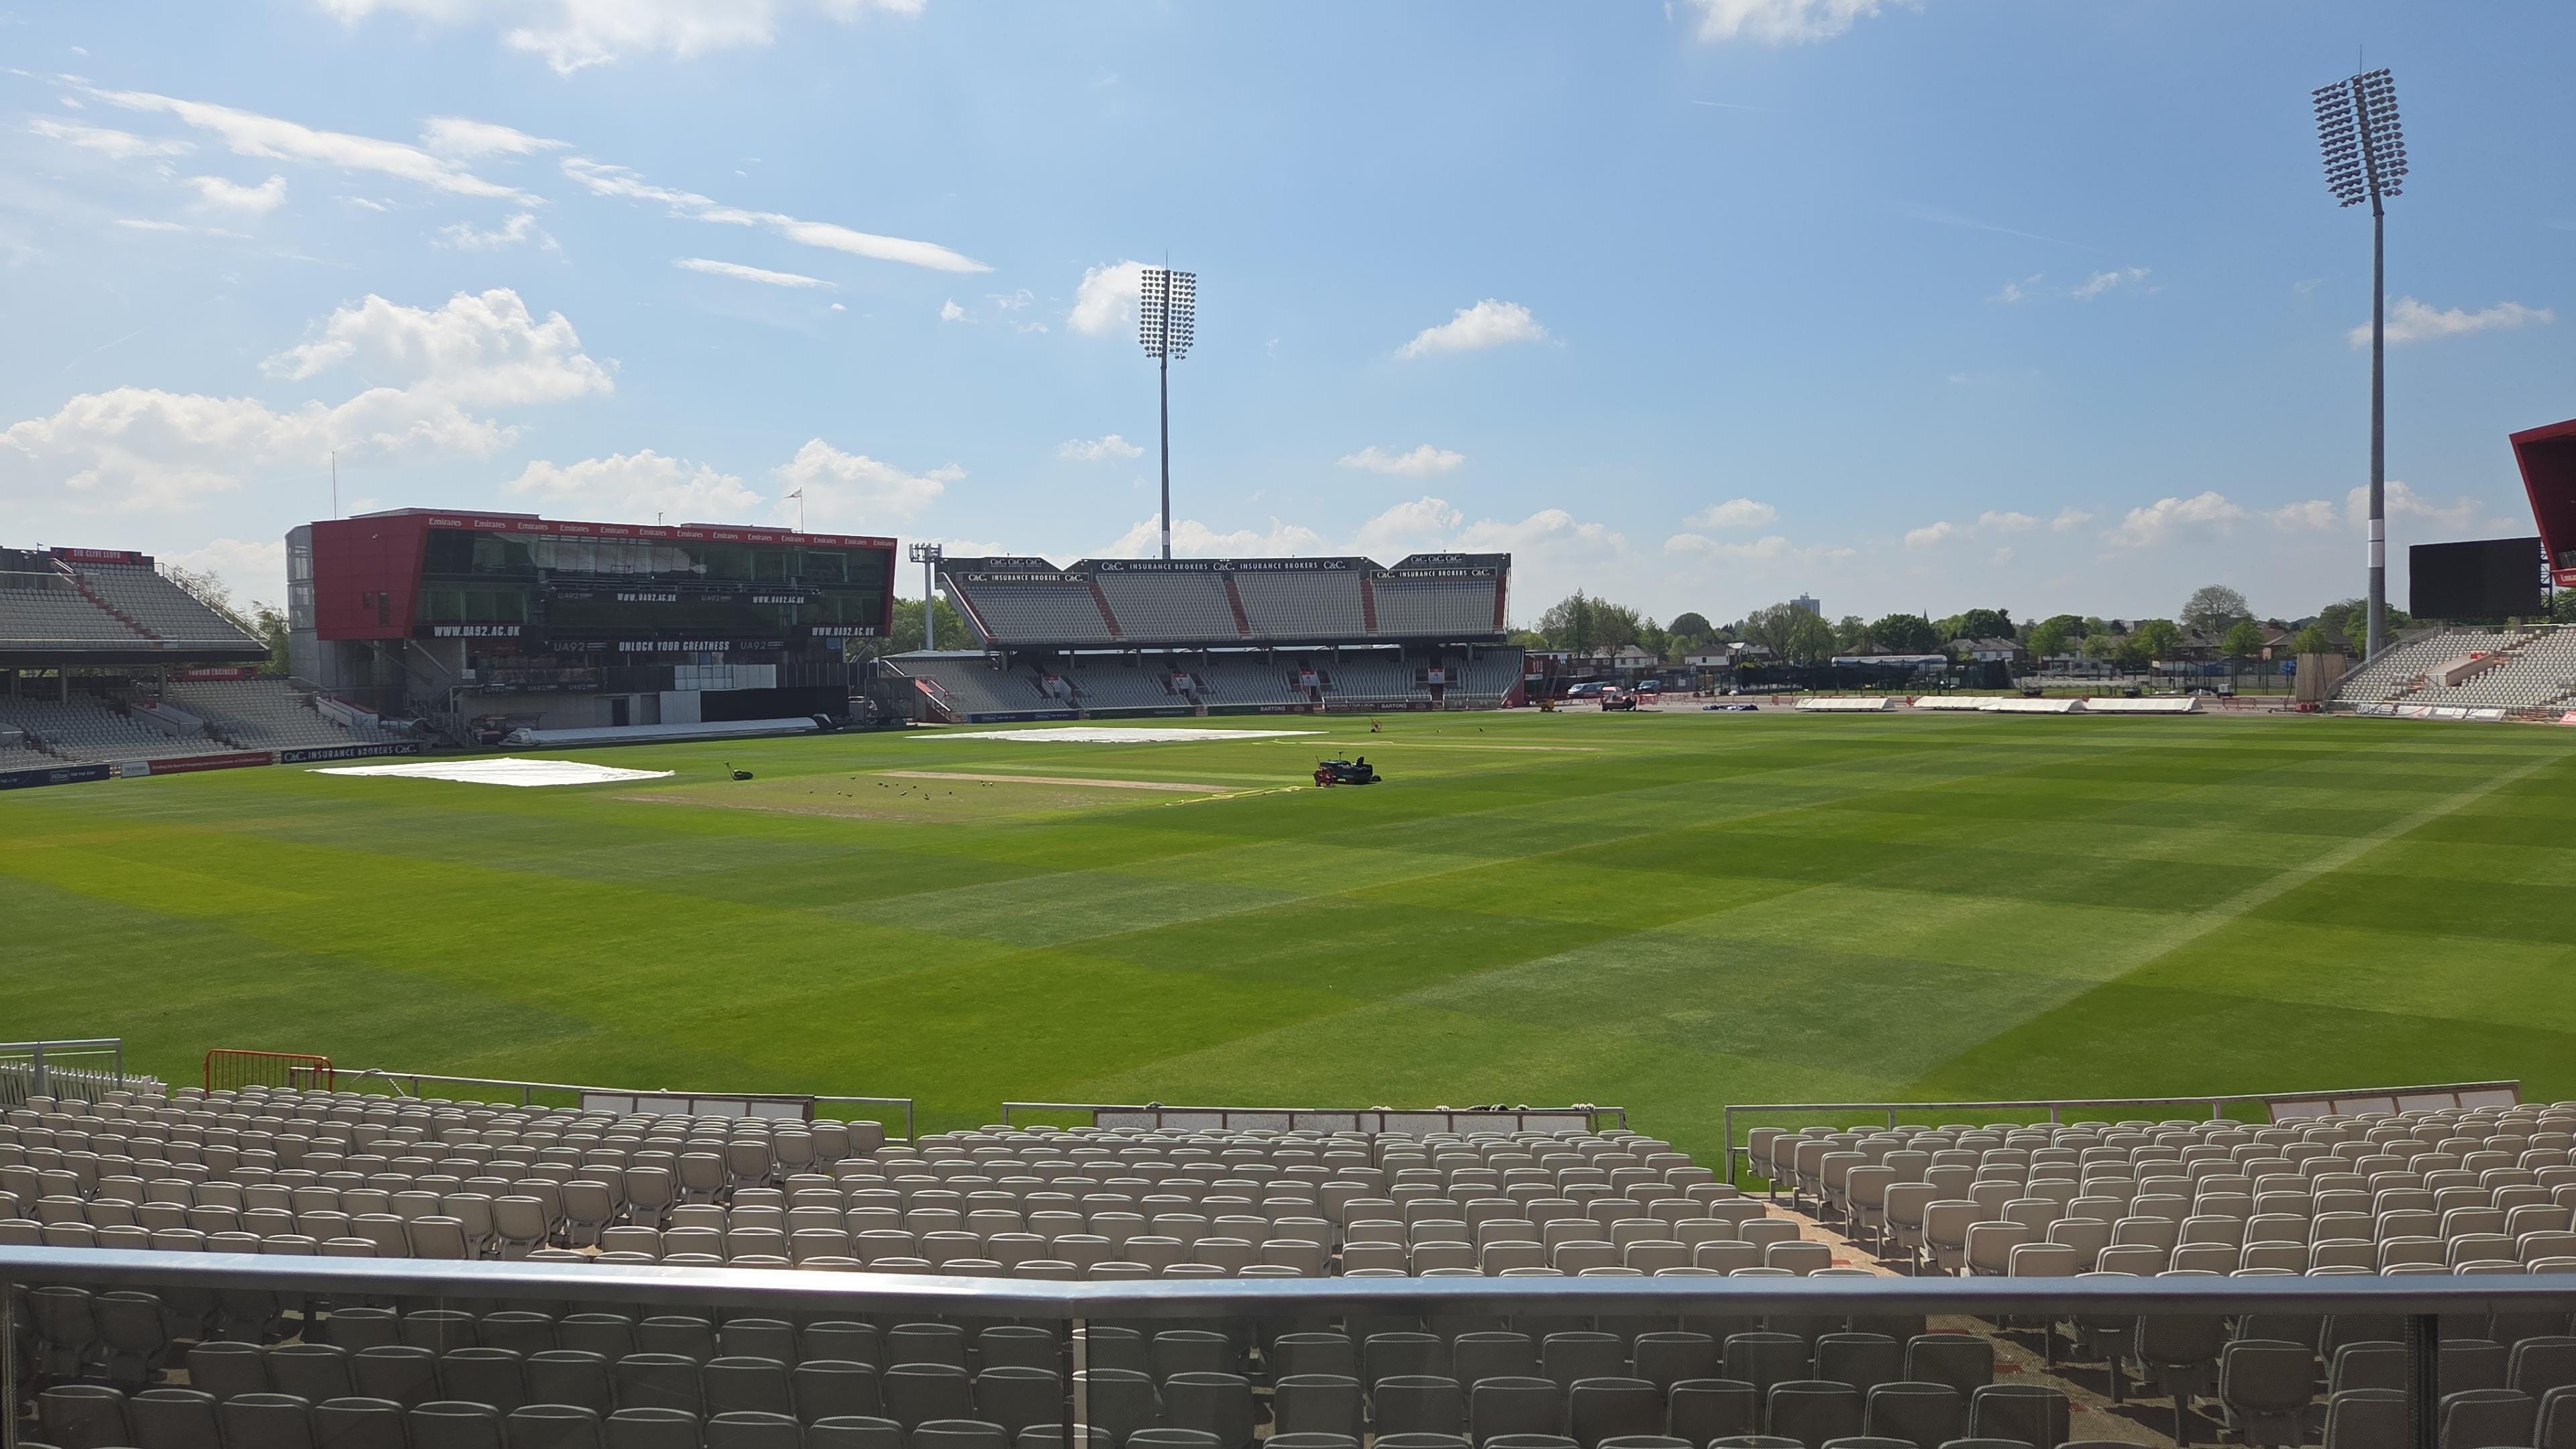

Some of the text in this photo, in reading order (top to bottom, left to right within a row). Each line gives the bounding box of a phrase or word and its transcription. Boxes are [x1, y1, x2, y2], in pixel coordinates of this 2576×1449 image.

[429, 518, 462, 526] Emirates
[474, 520, 506, 529] Emirates
[518, 522, 548, 530] Emirates
[559, 525, 589, 533] Emirates
[600, 527, 629, 535] Emirates
[639, 529, 667, 537] Emirates
[434, 626, 521, 637] WWW.UA92.AC.UK
[812, 627, 875, 636] WWW.UA92.AC.UK
[553, 642, 585, 651] UA92
[619, 641, 730, 651] UNLOCK YOUR GREATNESS
[741, 641, 766, 649] UA92
[308, 748, 355, 759] INSURANCE
[358, 746, 392, 756] BROKERS
